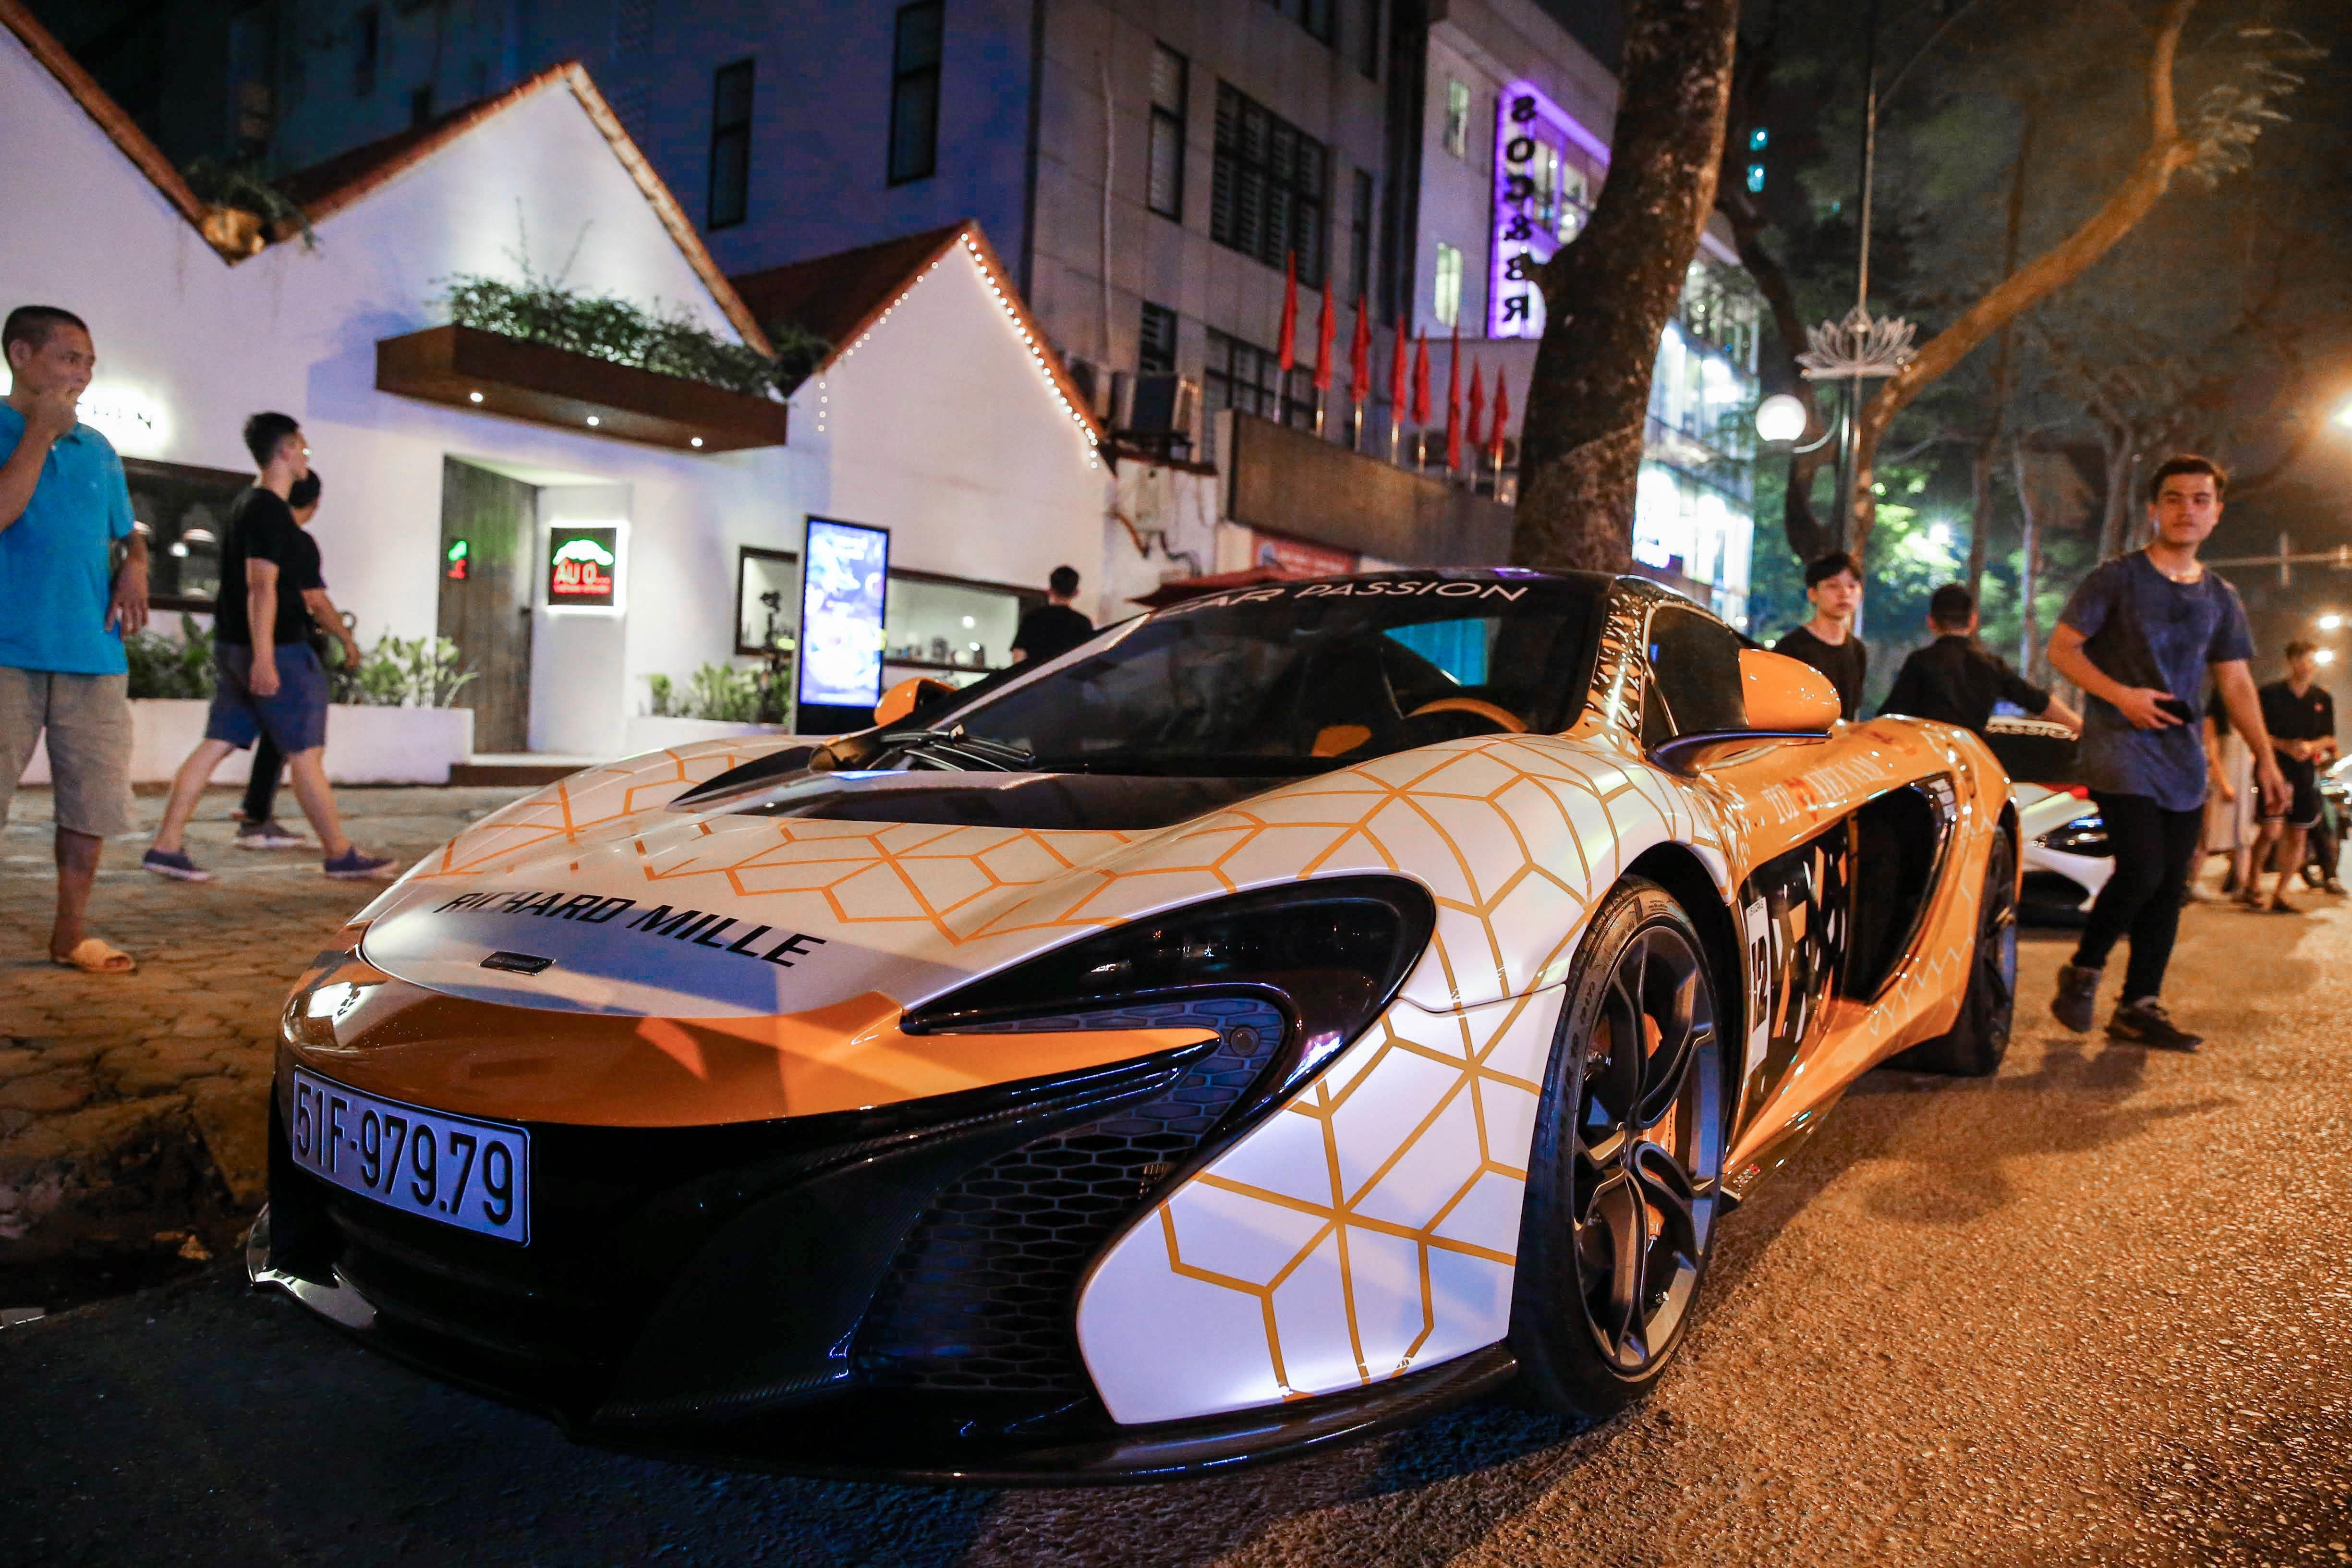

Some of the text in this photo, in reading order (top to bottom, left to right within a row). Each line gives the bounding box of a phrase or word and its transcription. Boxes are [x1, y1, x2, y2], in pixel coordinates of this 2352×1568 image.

[1152, 581, 1529, 619] CAR PASSION
[433, 891, 826, 968] RICHARD MILLE
